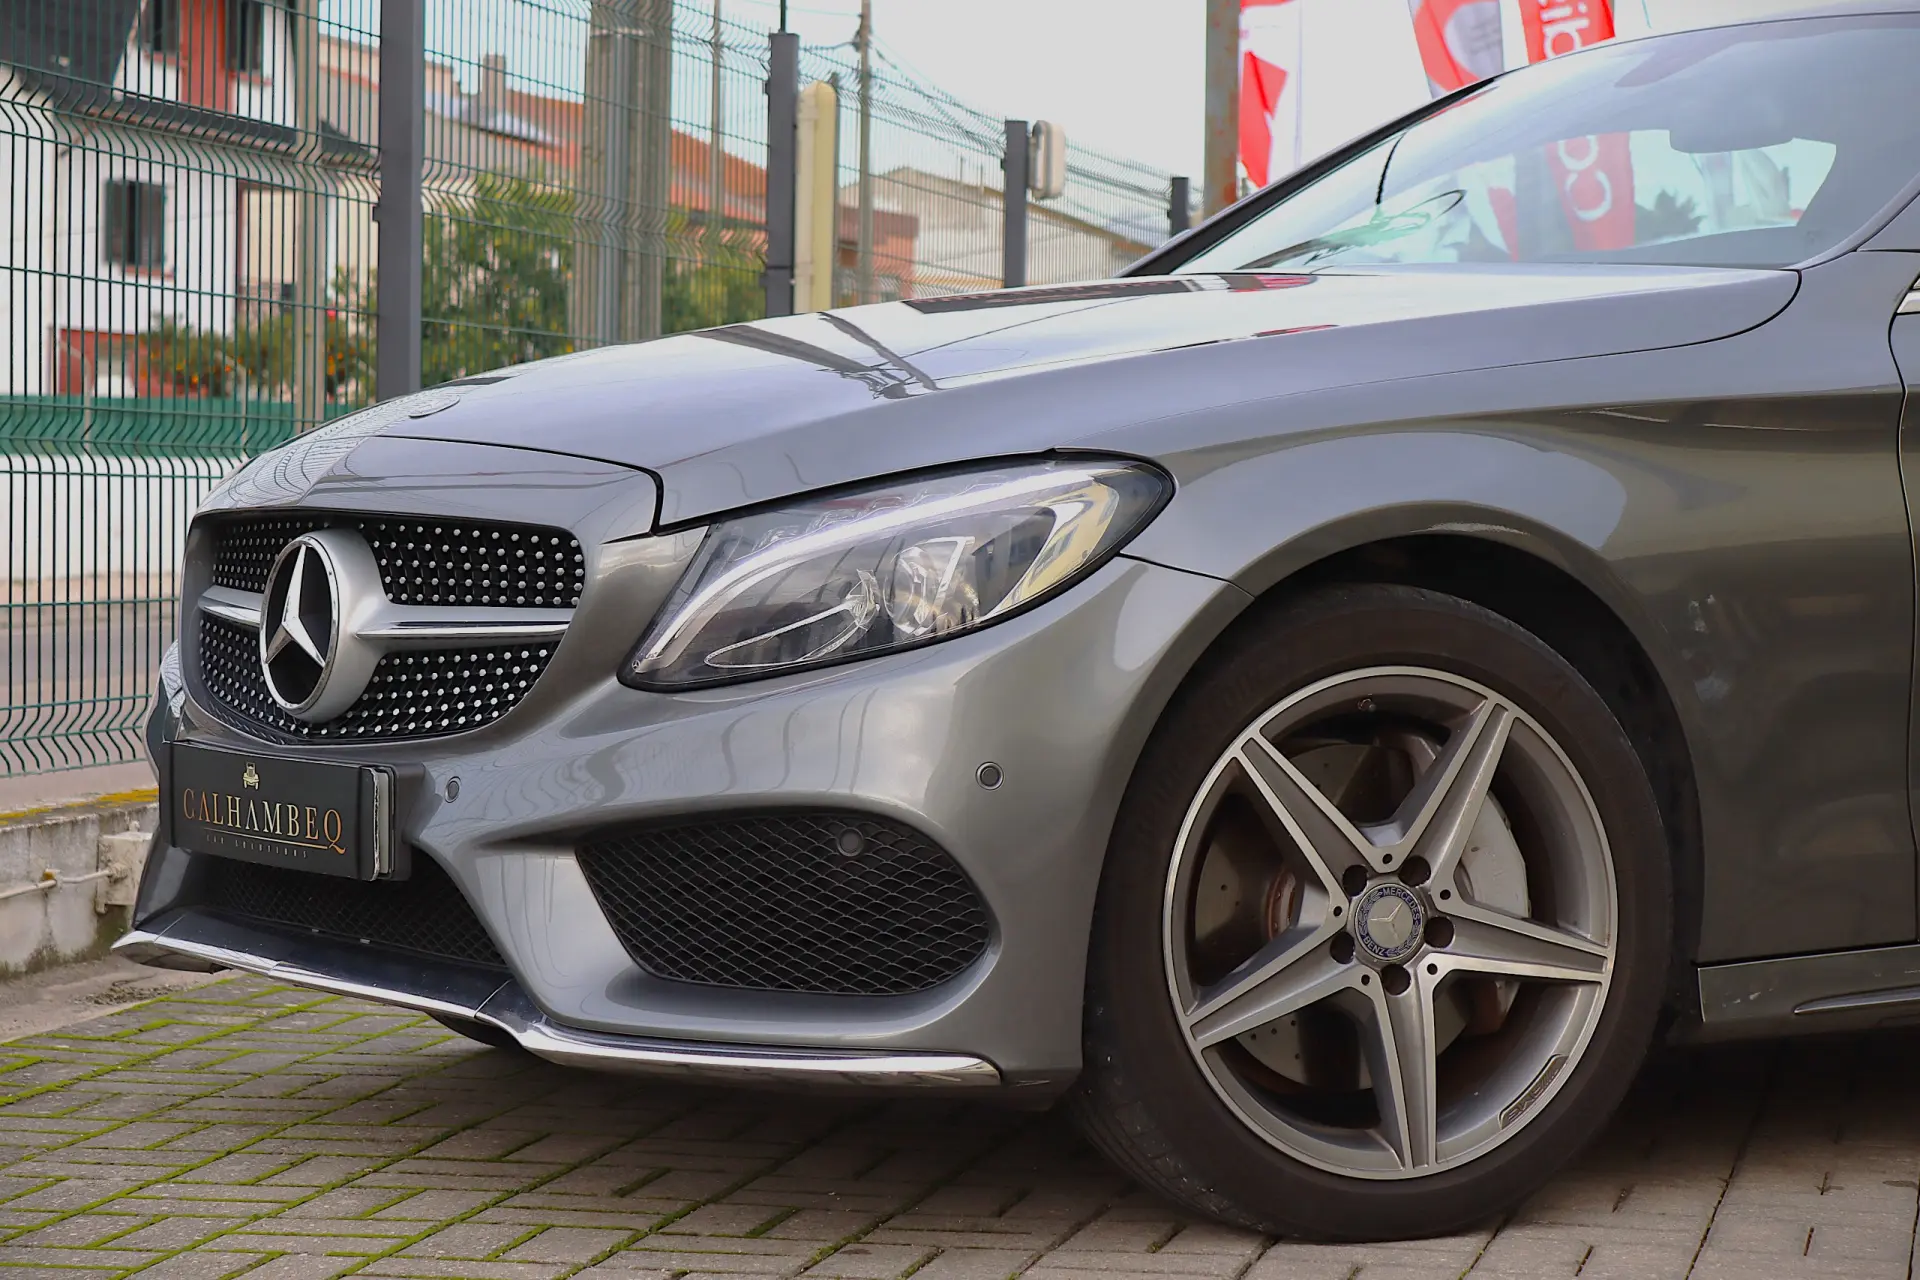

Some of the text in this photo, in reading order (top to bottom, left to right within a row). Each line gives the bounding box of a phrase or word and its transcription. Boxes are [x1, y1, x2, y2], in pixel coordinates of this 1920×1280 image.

[183, 788, 346, 854] CALHAMBEQ
[1382, 887, 1421, 922] MERCEDES
[1363, 935, 1386, 956] BENZ
